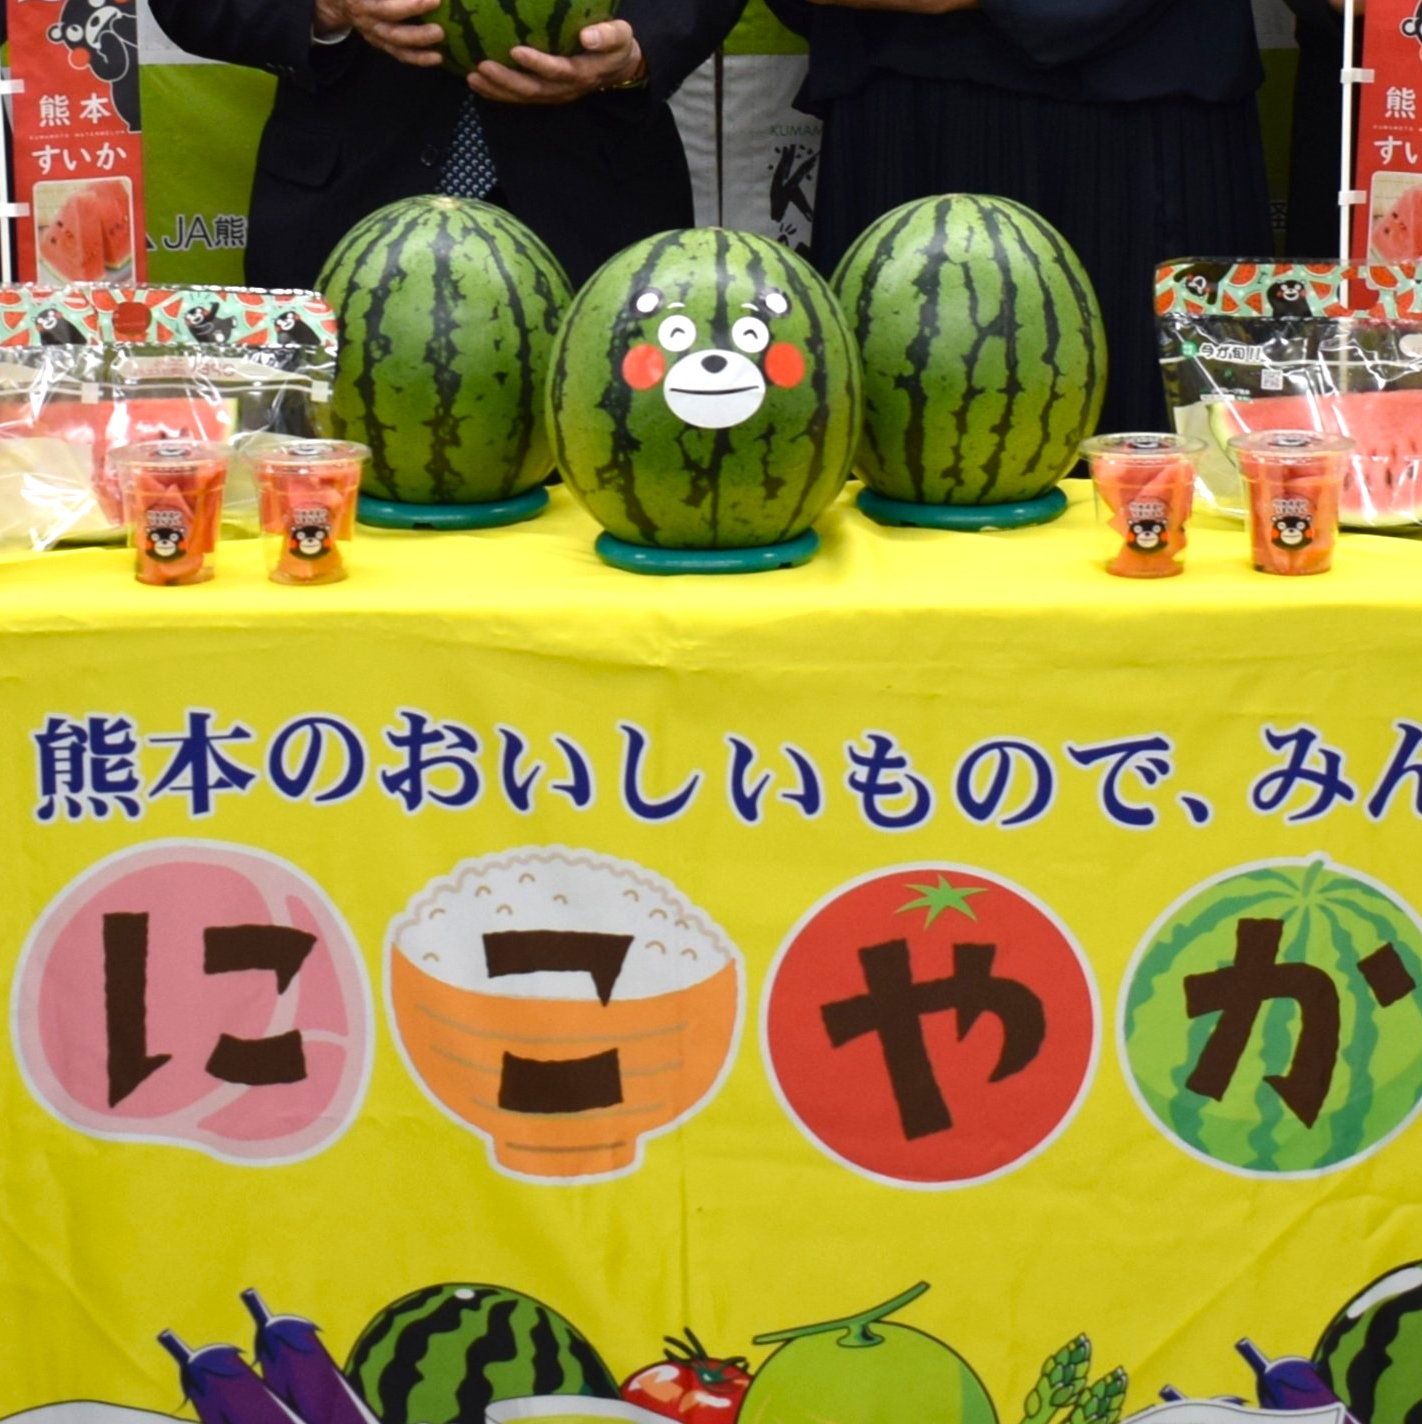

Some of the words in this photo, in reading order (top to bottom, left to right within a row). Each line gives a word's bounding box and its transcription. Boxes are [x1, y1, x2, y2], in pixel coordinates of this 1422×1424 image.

[39, 92, 113, 127] 熊本
[31, 142, 127, 173] すいか
